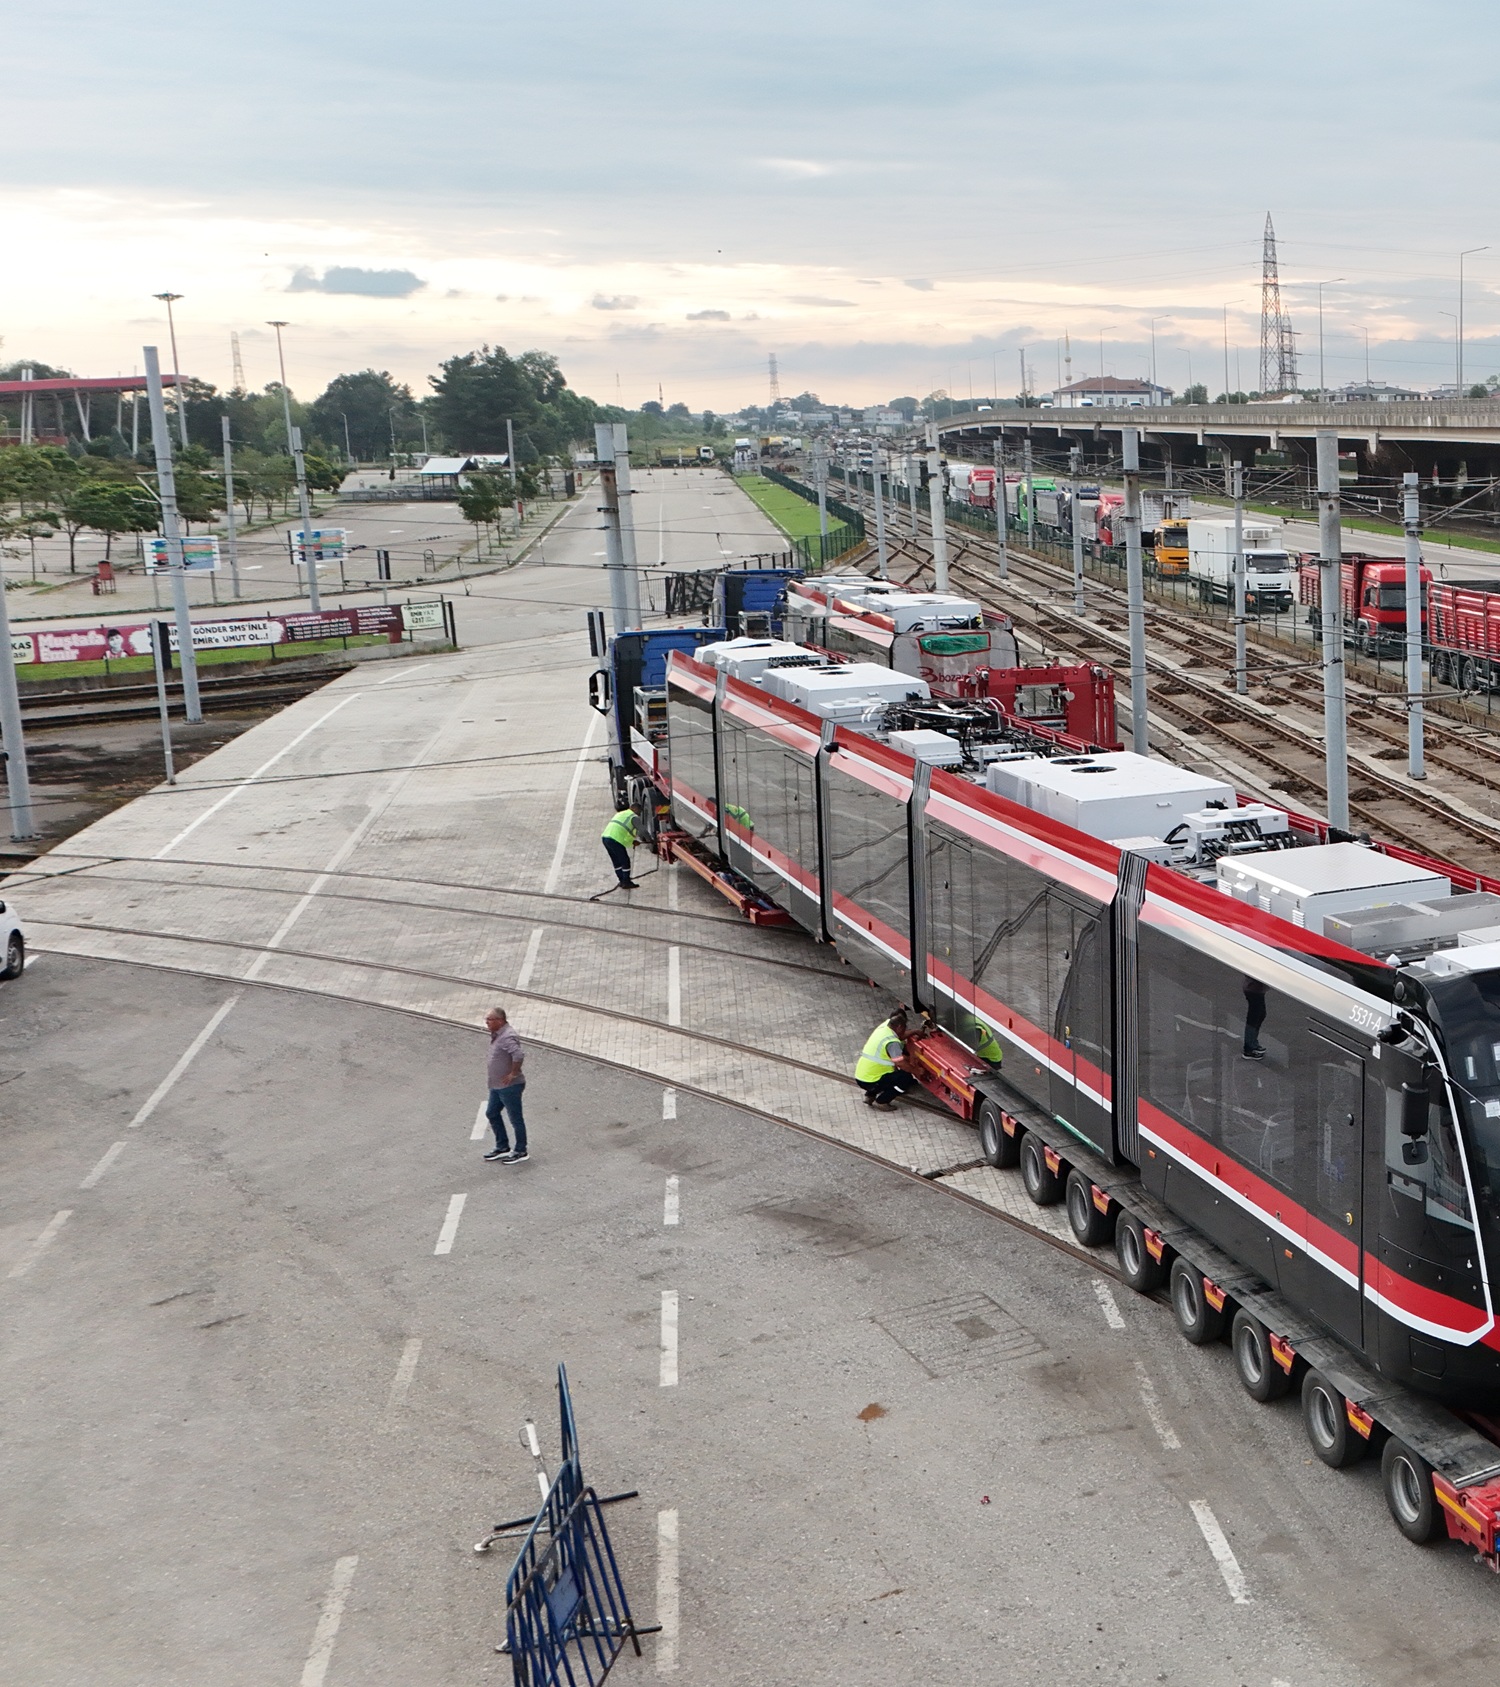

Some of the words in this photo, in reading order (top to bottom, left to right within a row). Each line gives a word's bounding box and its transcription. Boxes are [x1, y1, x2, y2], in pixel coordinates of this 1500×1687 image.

[194, 624, 227, 635] GÖNDER
[222, 634, 247, 643] UMUT
[938, 673, 965, 682] boza
[1348, 1004, 1382, 1032] 5531-A
